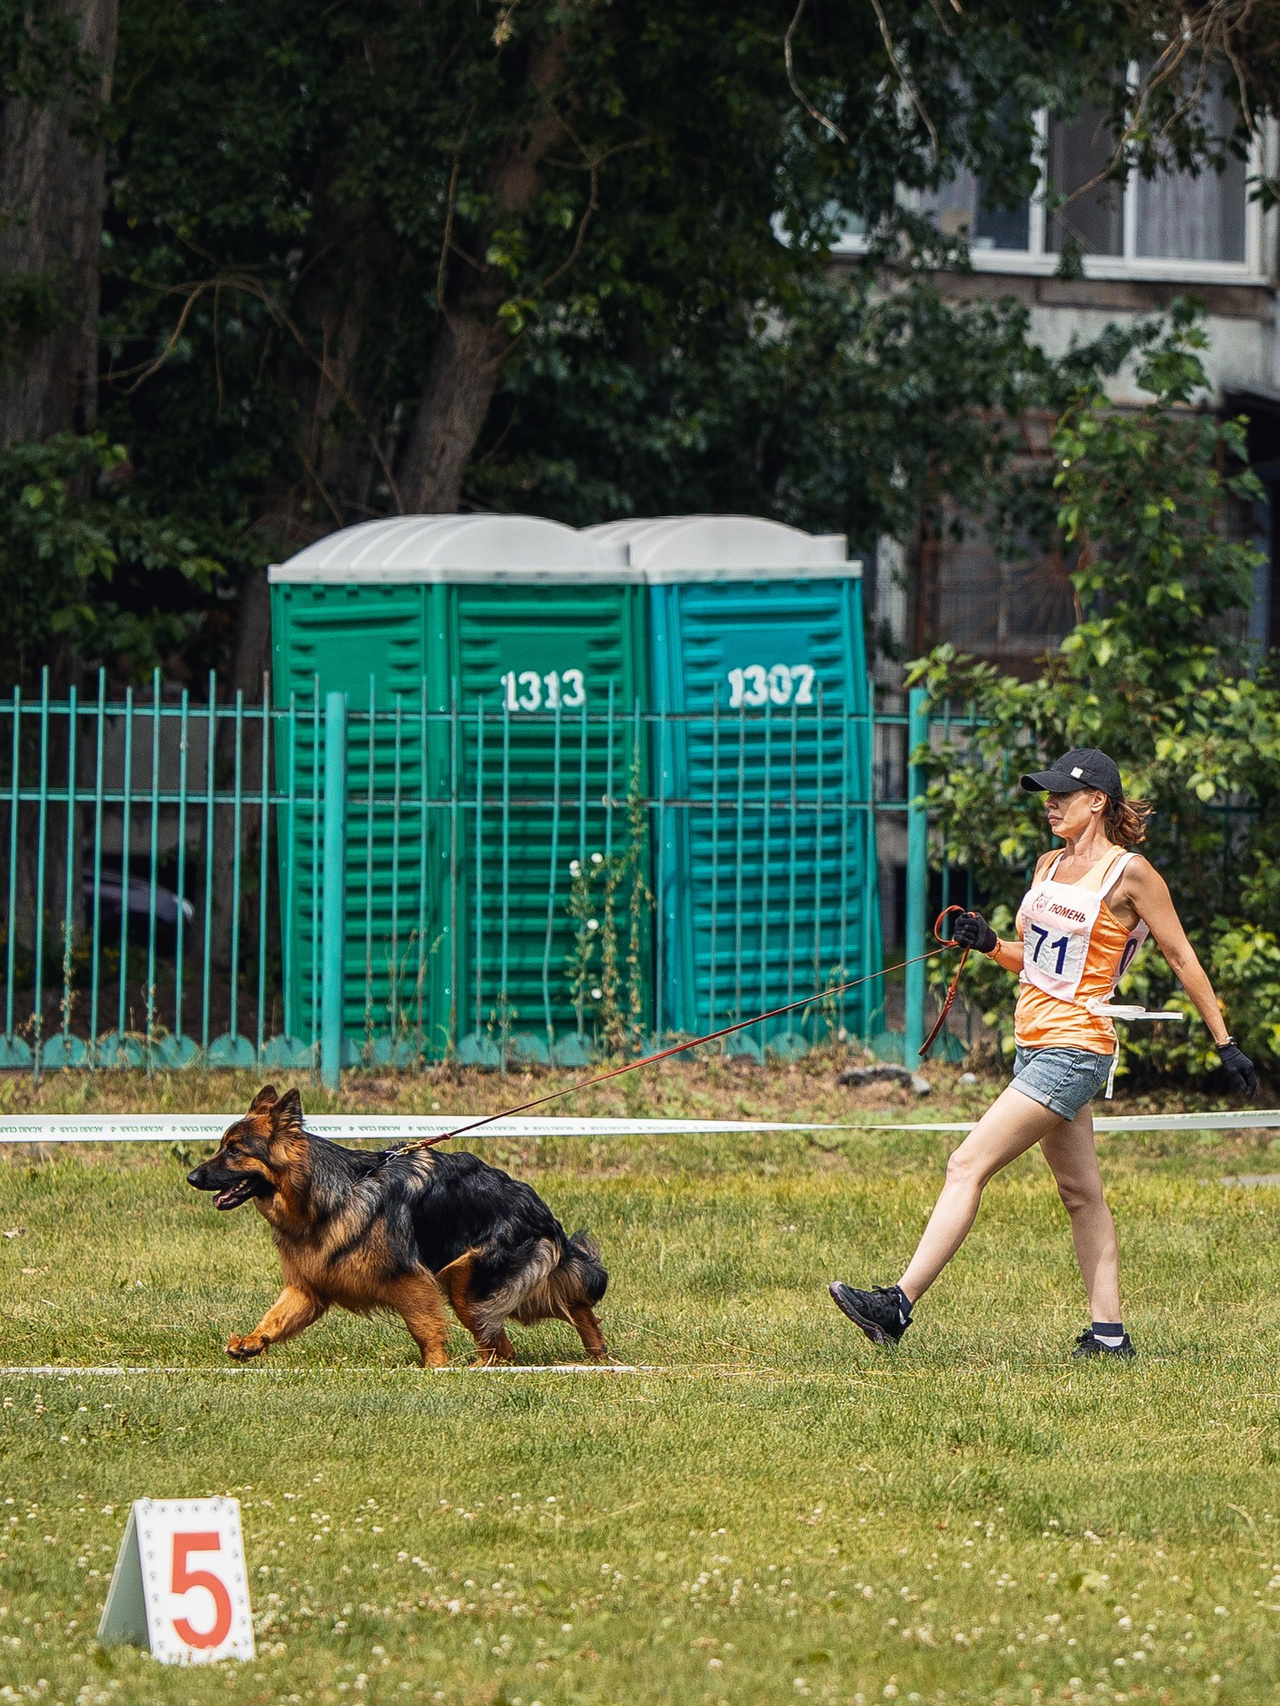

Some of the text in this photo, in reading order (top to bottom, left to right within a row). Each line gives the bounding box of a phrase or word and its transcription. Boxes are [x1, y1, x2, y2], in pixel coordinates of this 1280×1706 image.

[501, 669, 587, 711] 1313
[728, 664, 815, 707] 1307
[1048, 903, 1086, 923] ТЮМЕНЬ
[1031, 923, 1069, 975] 71
[172, 1532, 232, 1650] 5
